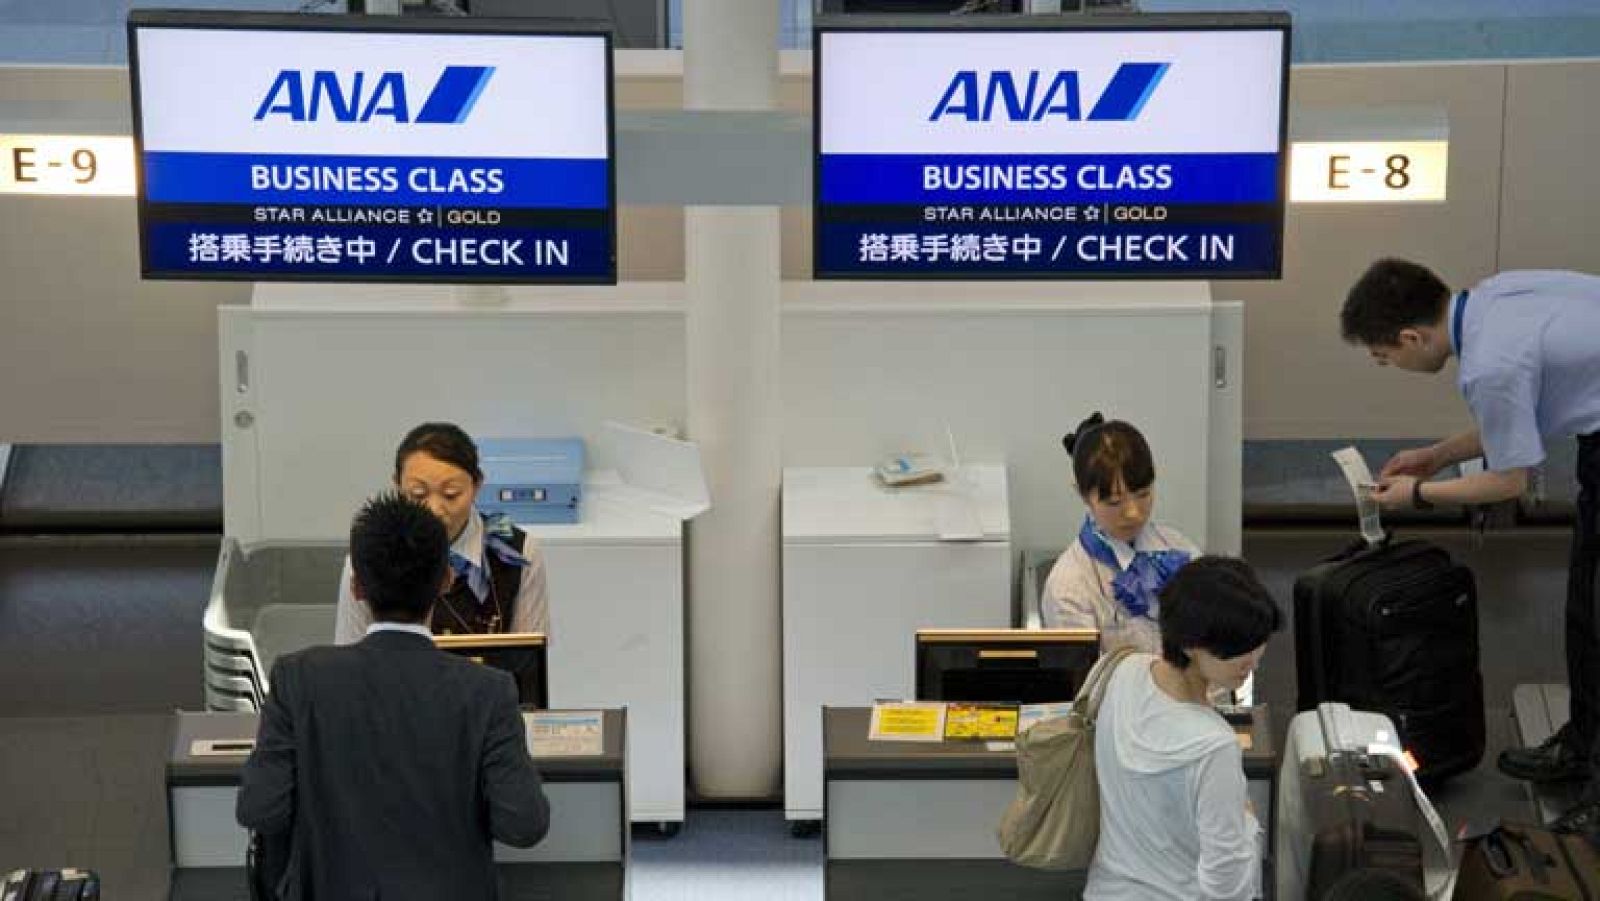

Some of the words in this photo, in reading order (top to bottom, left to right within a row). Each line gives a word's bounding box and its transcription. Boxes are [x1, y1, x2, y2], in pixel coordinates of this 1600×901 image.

[253, 69, 410, 123] ANA
[928, 70, 1082, 122] ANA
[12, 147, 98, 184] E-9
[250, 166, 399, 193] BUSINESS
[408, 168, 505, 194] CLASS
[922, 165, 1067, 191] BUSINESS
[1077, 165, 1173, 190] CLASS
[1327, 154, 1412, 190] E-8
[253, 207, 305, 223] STAR
[311, 208, 410, 224] ALLIANCE
[447, 210, 501, 225] GOLD
[923, 206, 974, 221] STAR
[979, 206, 1078, 221] ALLIANCE
[1113, 206, 1168, 221] GOLD
[188, 233, 377, 264] 搭乗手続き中
[412, 238, 525, 266] CHECK
[535, 240, 569, 266] IN
[858, 233, 1042, 263] 搭乗手続き中
[1077, 235, 1189, 262] CHECK
[1200, 236, 1235, 262] IN
